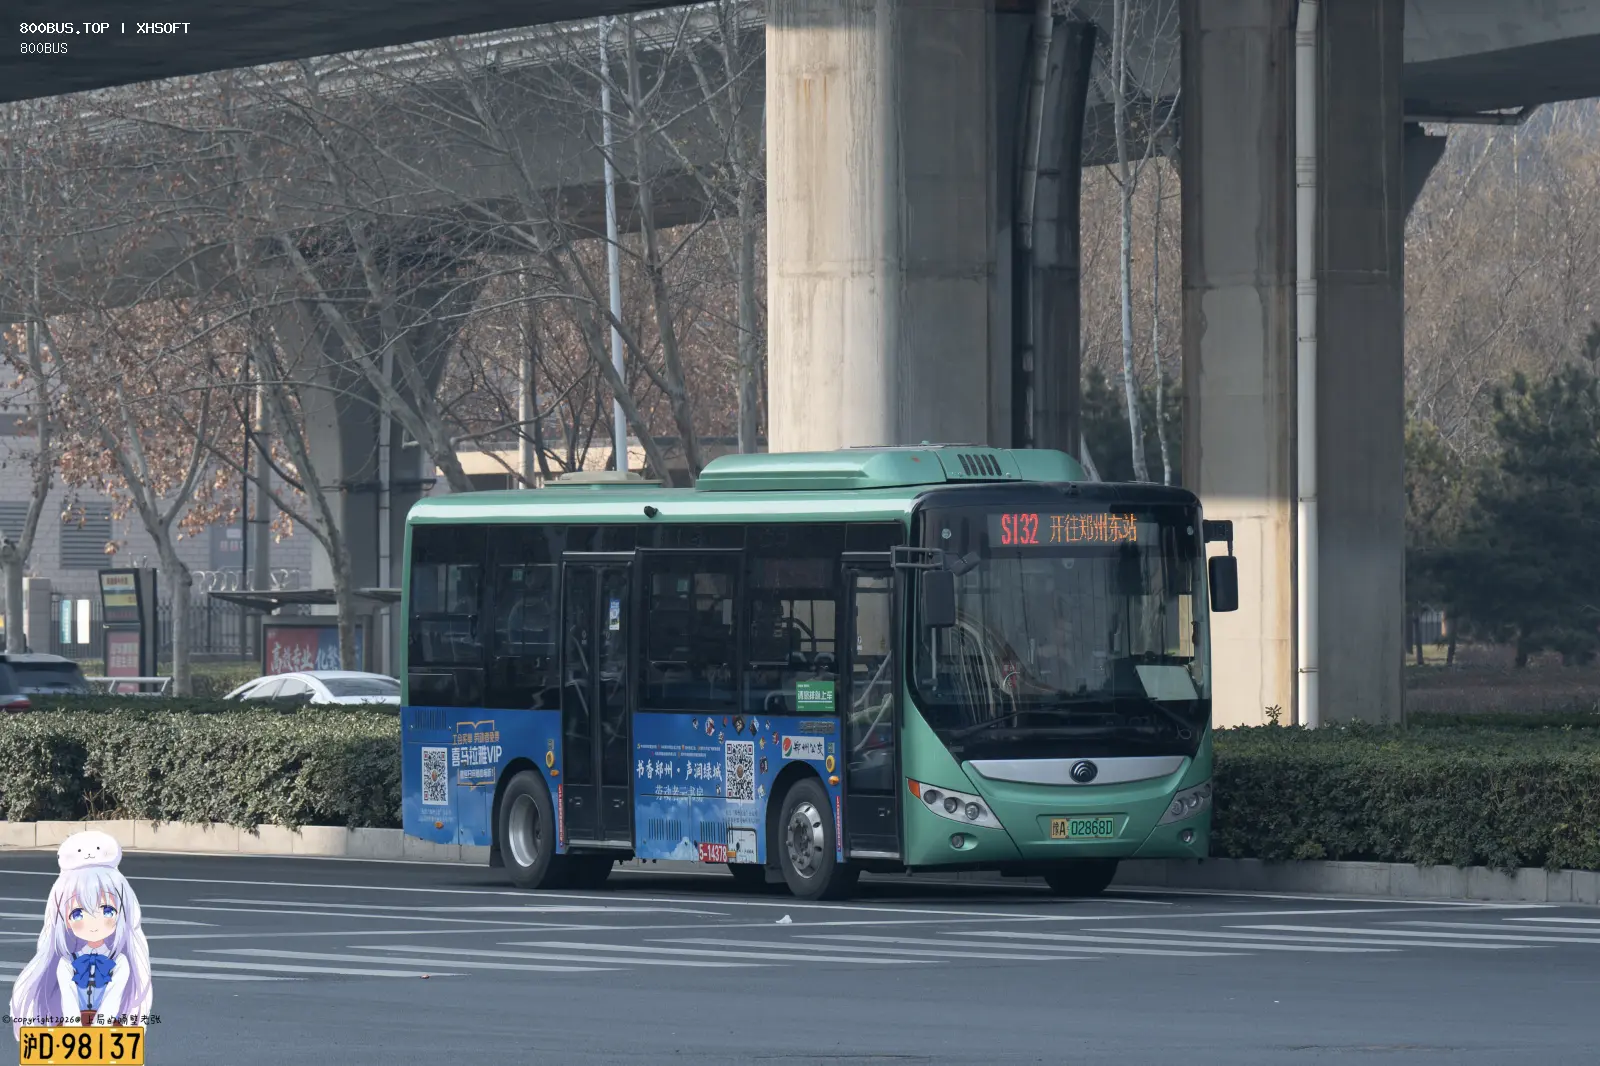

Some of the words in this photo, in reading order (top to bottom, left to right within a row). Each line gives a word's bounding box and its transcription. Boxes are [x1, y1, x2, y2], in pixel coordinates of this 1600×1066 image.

[1001, 513, 1040, 545] S132
[1049, 513, 1138, 543] 开往郑州东站
[451, 745, 503, 768] 喜马拉雅VIP
[792, 739, 824, 757] 郑州公交
[699, 843, 728, 862] 5-14378
